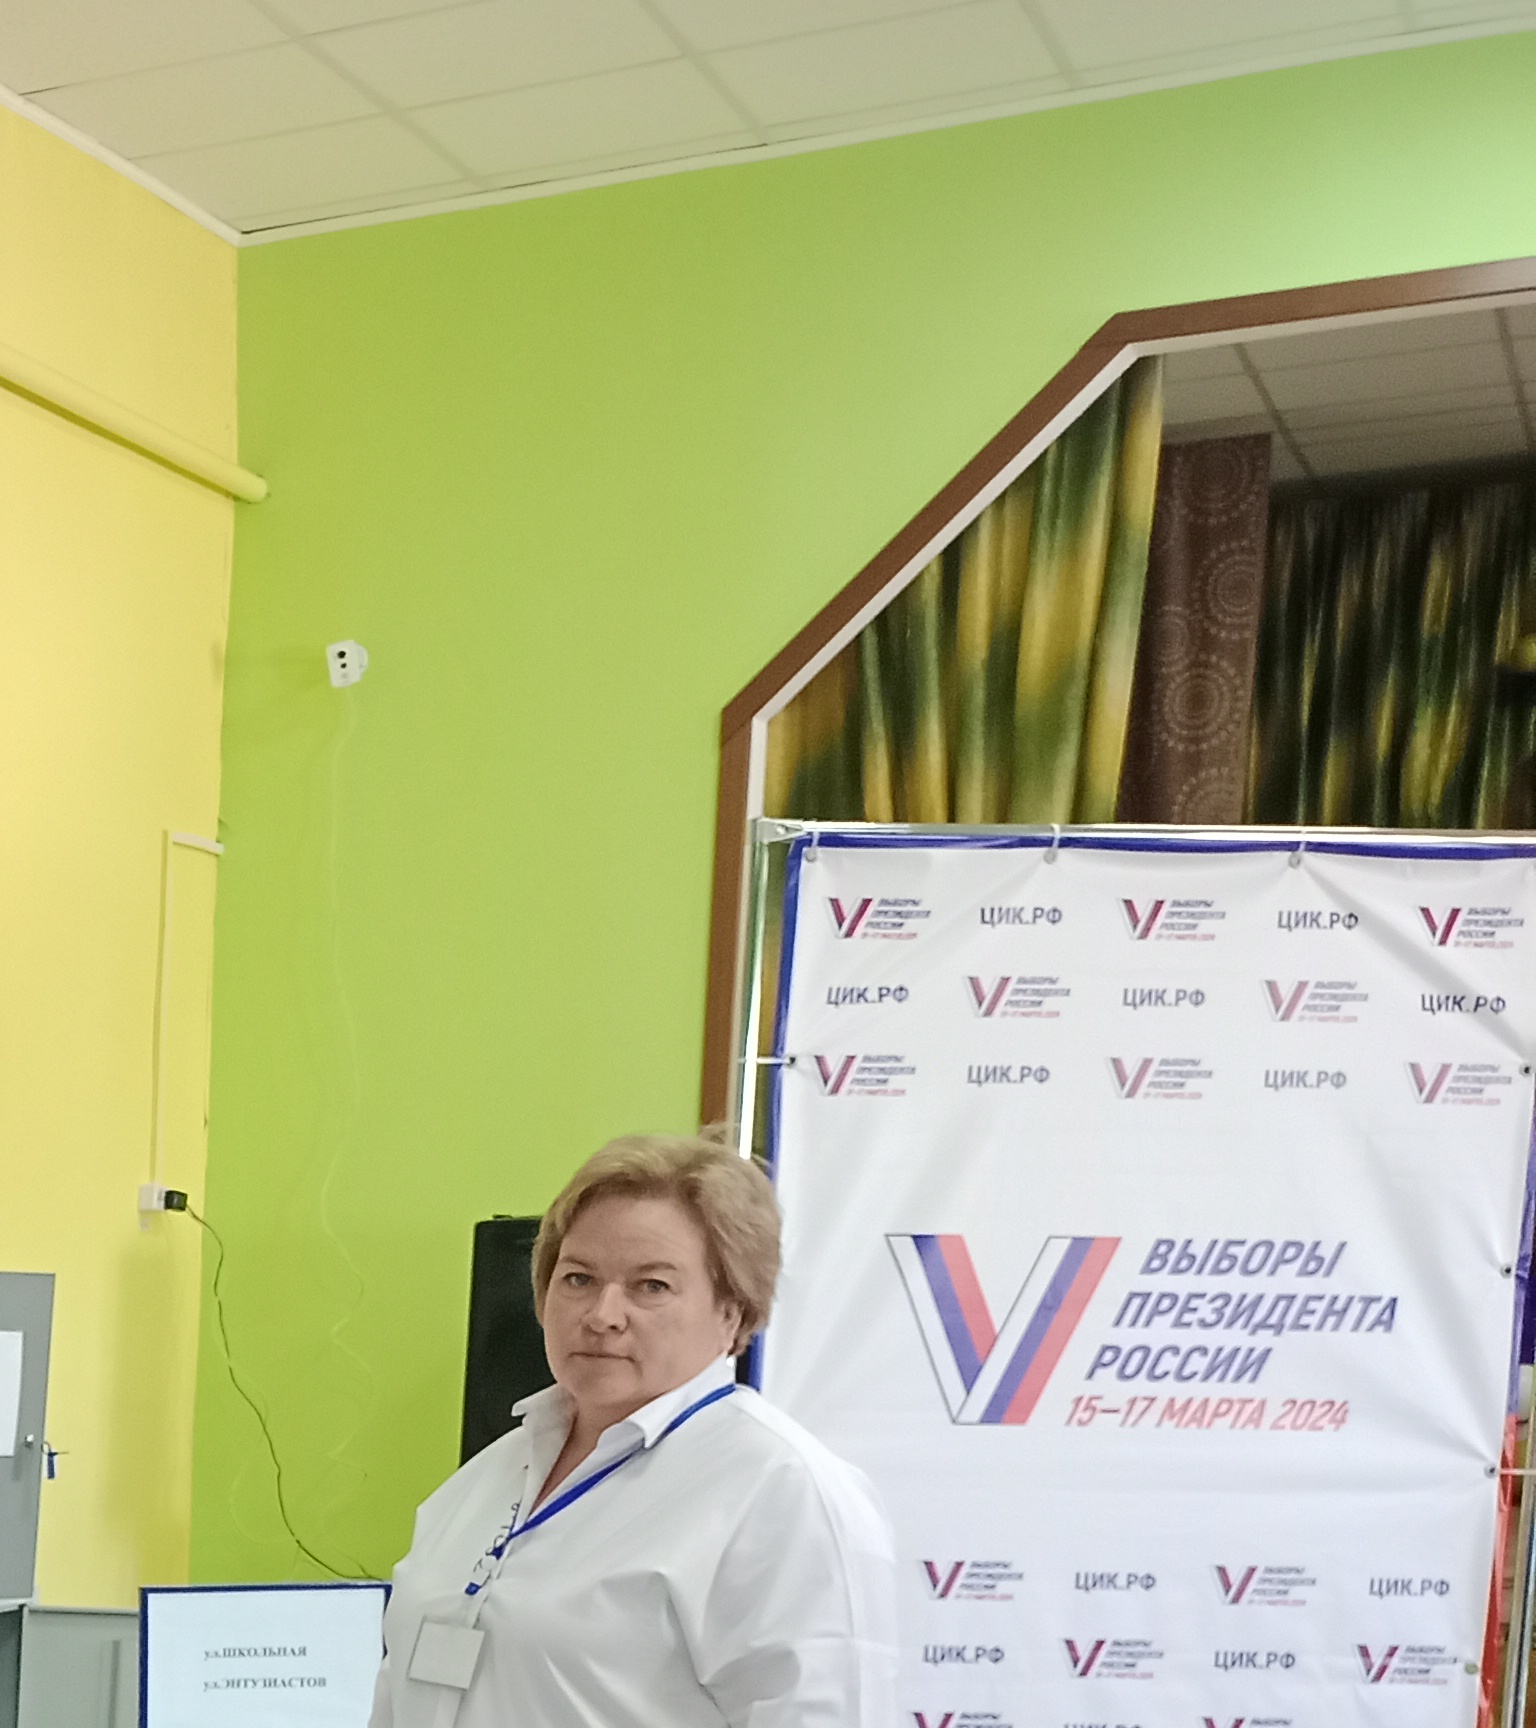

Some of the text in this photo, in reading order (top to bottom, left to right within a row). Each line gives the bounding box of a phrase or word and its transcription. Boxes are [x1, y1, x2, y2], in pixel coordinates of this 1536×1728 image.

[980, 906, 1063, 928] ЦИК.РФ
[1277, 910, 1359, 932] ЦИК.РФ
[826, 985, 909, 1007] ЦИК.РФ
[1122, 988, 1206, 1010] ЦИК.РФ
[1420, 993, 1506, 1015] ЦИК.РФ
[967, 1065, 1050, 1087] ЦИК.РФ
[1264, 1070, 1347, 1091] ЦИК.РФ
[1139, 1239, 1348, 1278] ВЫБОРЫ
[1111, 1293, 1399, 1338] ПРЕЗИДЕНТА
[1085, 1345, 1273, 1382] РОССИИ
[1156, 1399, 1265, 1430] МАРТА
[1269, 1399, 1349, 1431] 2024
[1074, 1572, 1157, 1593] ЦИК.РФ
[1369, 1578, 1450, 1599] ЦИК.РФ
[923, 1645, 1005, 1666] ЦИК.РФ
[1214, 1650, 1296, 1672] ЦИК.РФ
